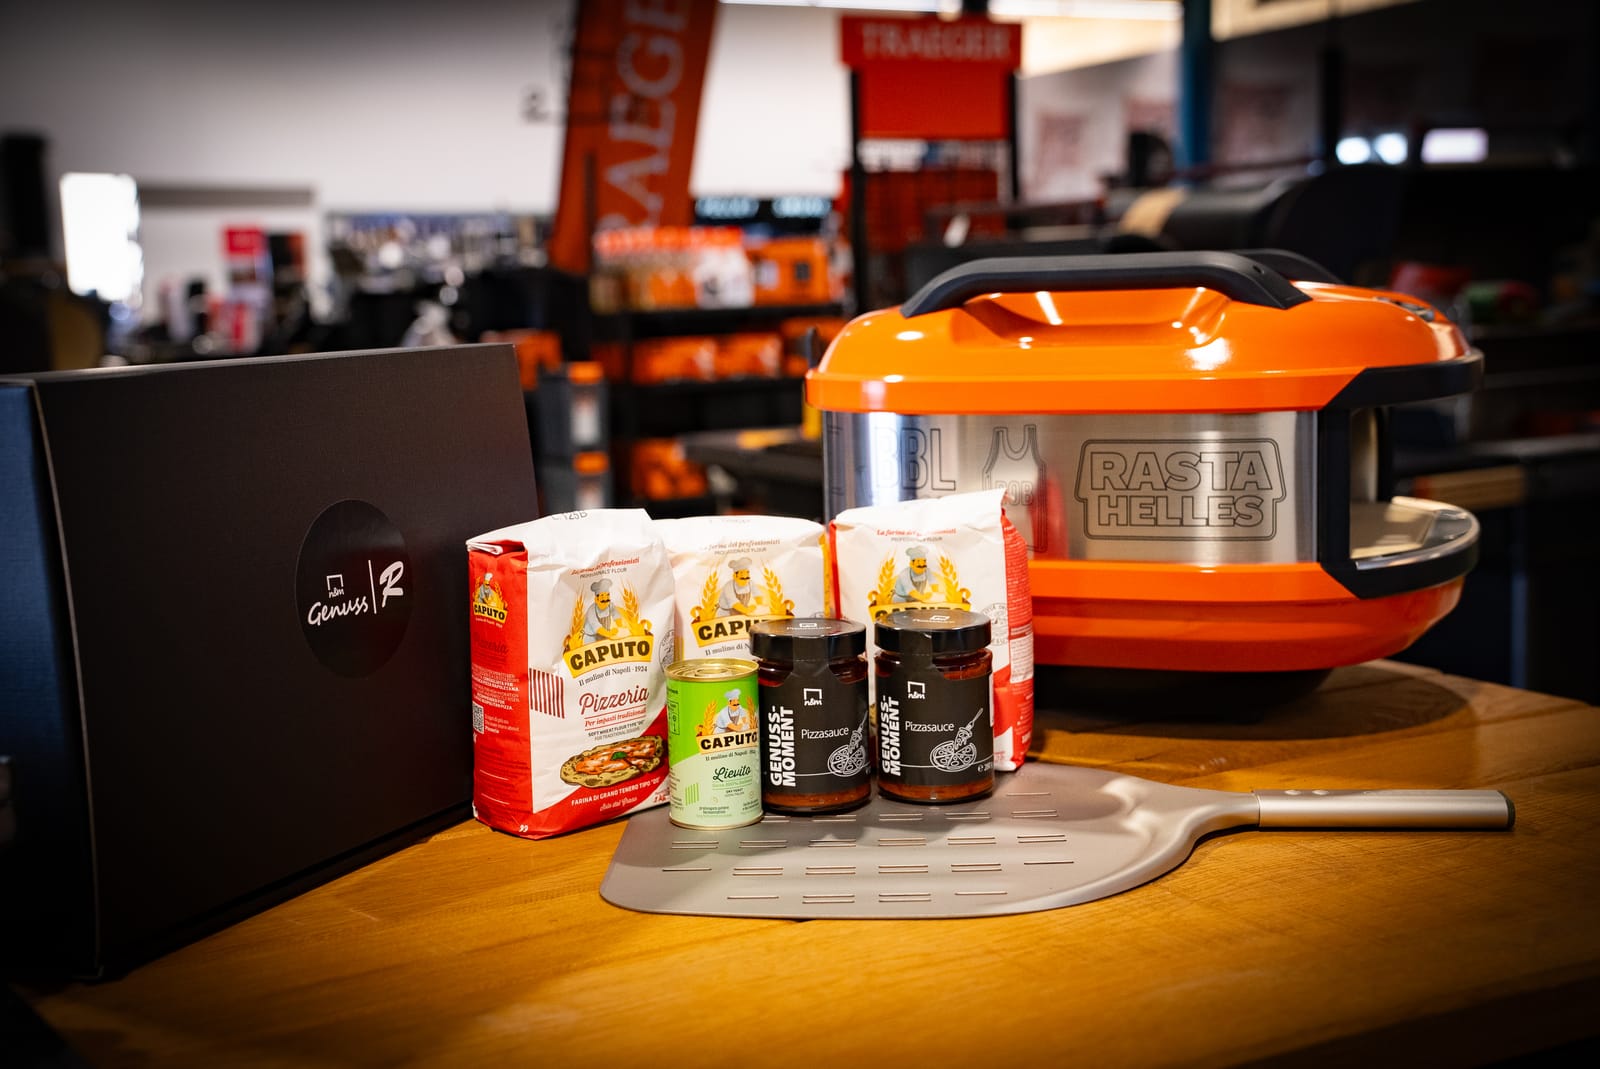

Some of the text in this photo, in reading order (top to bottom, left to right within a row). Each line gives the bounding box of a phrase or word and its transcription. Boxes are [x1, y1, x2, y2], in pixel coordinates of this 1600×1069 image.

[1090, 451, 1273, 491] RASTA
[1099, 496, 1264, 527] HELLES
[308, 560, 404, 626] Genuss R
[474, 604, 505, 621] CAPUTO
[570, 640, 650, 672] CAPUTO
[585, 674, 605, 684] mulino
[605, 670, 611, 678] di
[612, 666, 631, 676] Napoli
[579, 685, 650, 715] Pizzeria
[584, 720, 595, 728] Per
[596, 715, 617, 725] impasti
[802, 728, 849, 739] Pizzasauce
[880, 695, 891, 774] GENUSS-
[888, 696, 901, 776] MOMENT
[905, 720, 955, 732] Pizzasauce
[700, 732, 758, 750] CAPUTO
[768, 706, 782, 786] GENUSS-
[780, 706, 796, 787] MOMENT
[712, 765, 751, 782] Lievito
[572, 795, 593, 807] FARINA
[600, 789, 619, 800] GRANO
[619, 784, 639, 794] TENERO
[639, 780, 651, 789] TIPO
